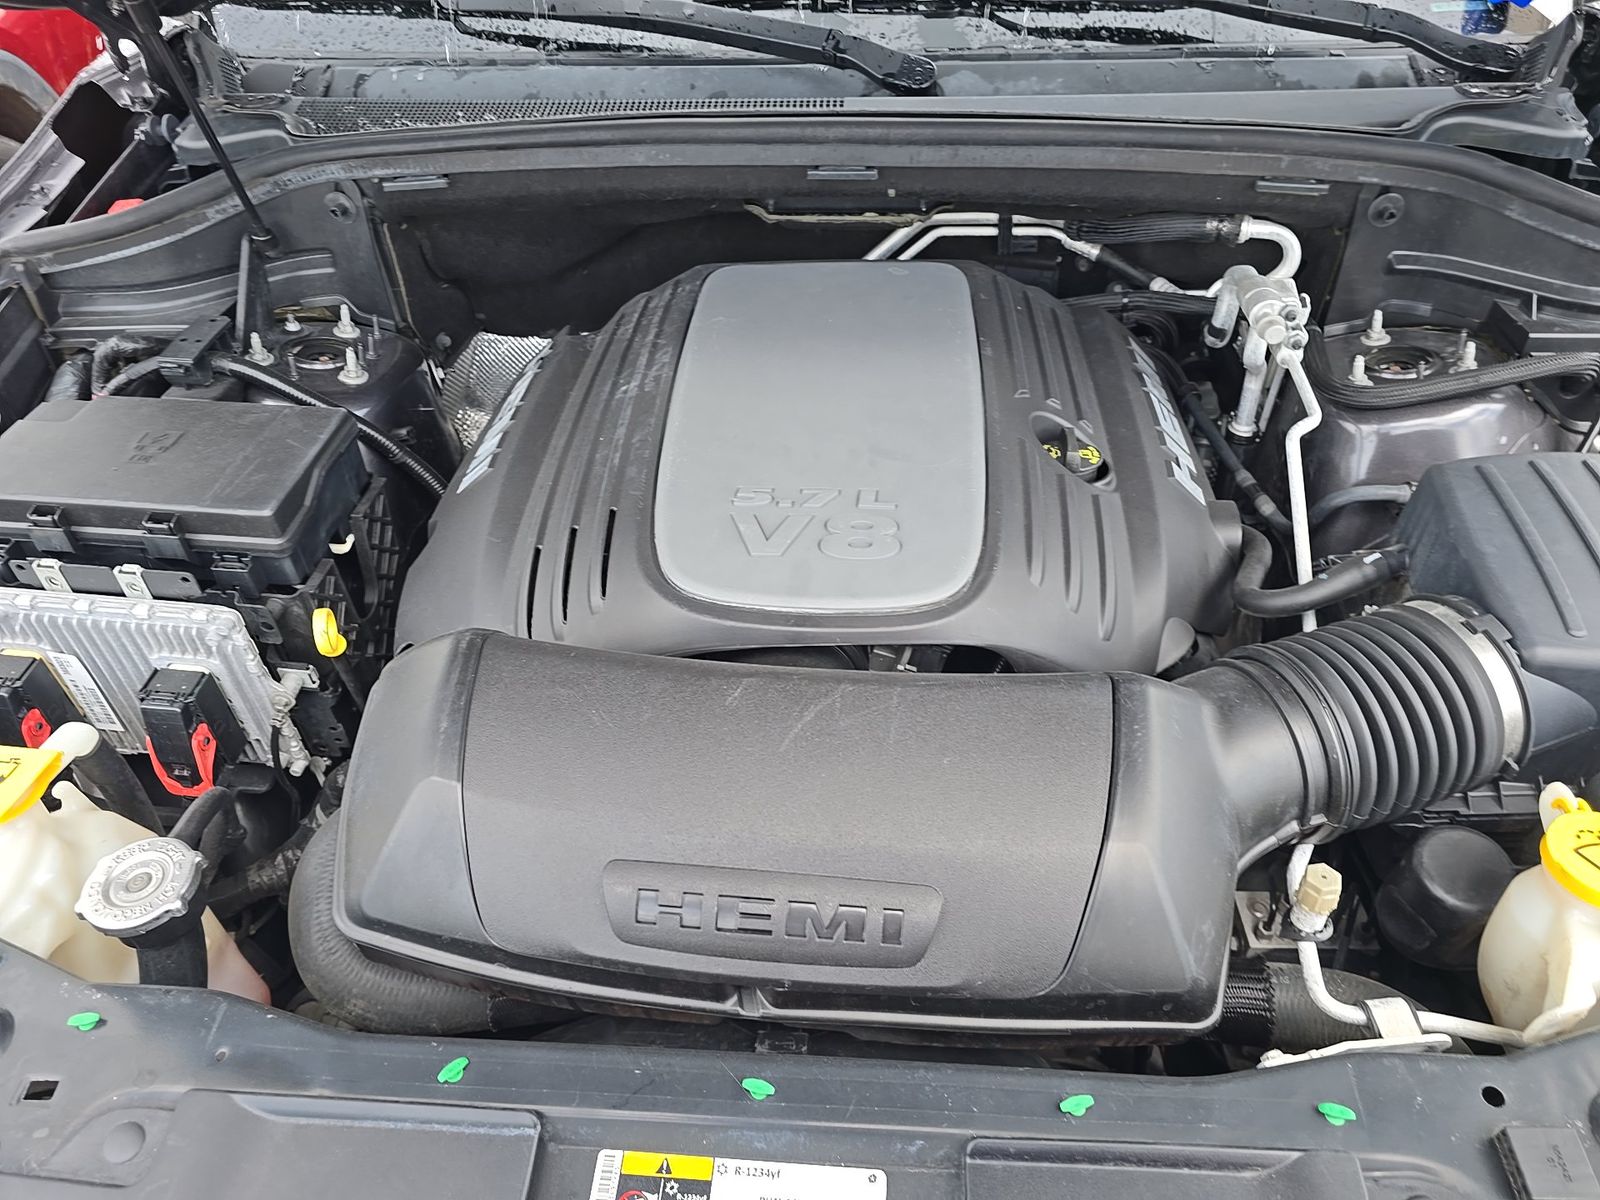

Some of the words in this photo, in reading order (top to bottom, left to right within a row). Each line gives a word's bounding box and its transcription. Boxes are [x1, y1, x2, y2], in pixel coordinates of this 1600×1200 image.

[729, 512, 904, 560] V8
[634, 888, 906, 946] HEMI
[734, 1165, 781, 1180] R-1234yf
